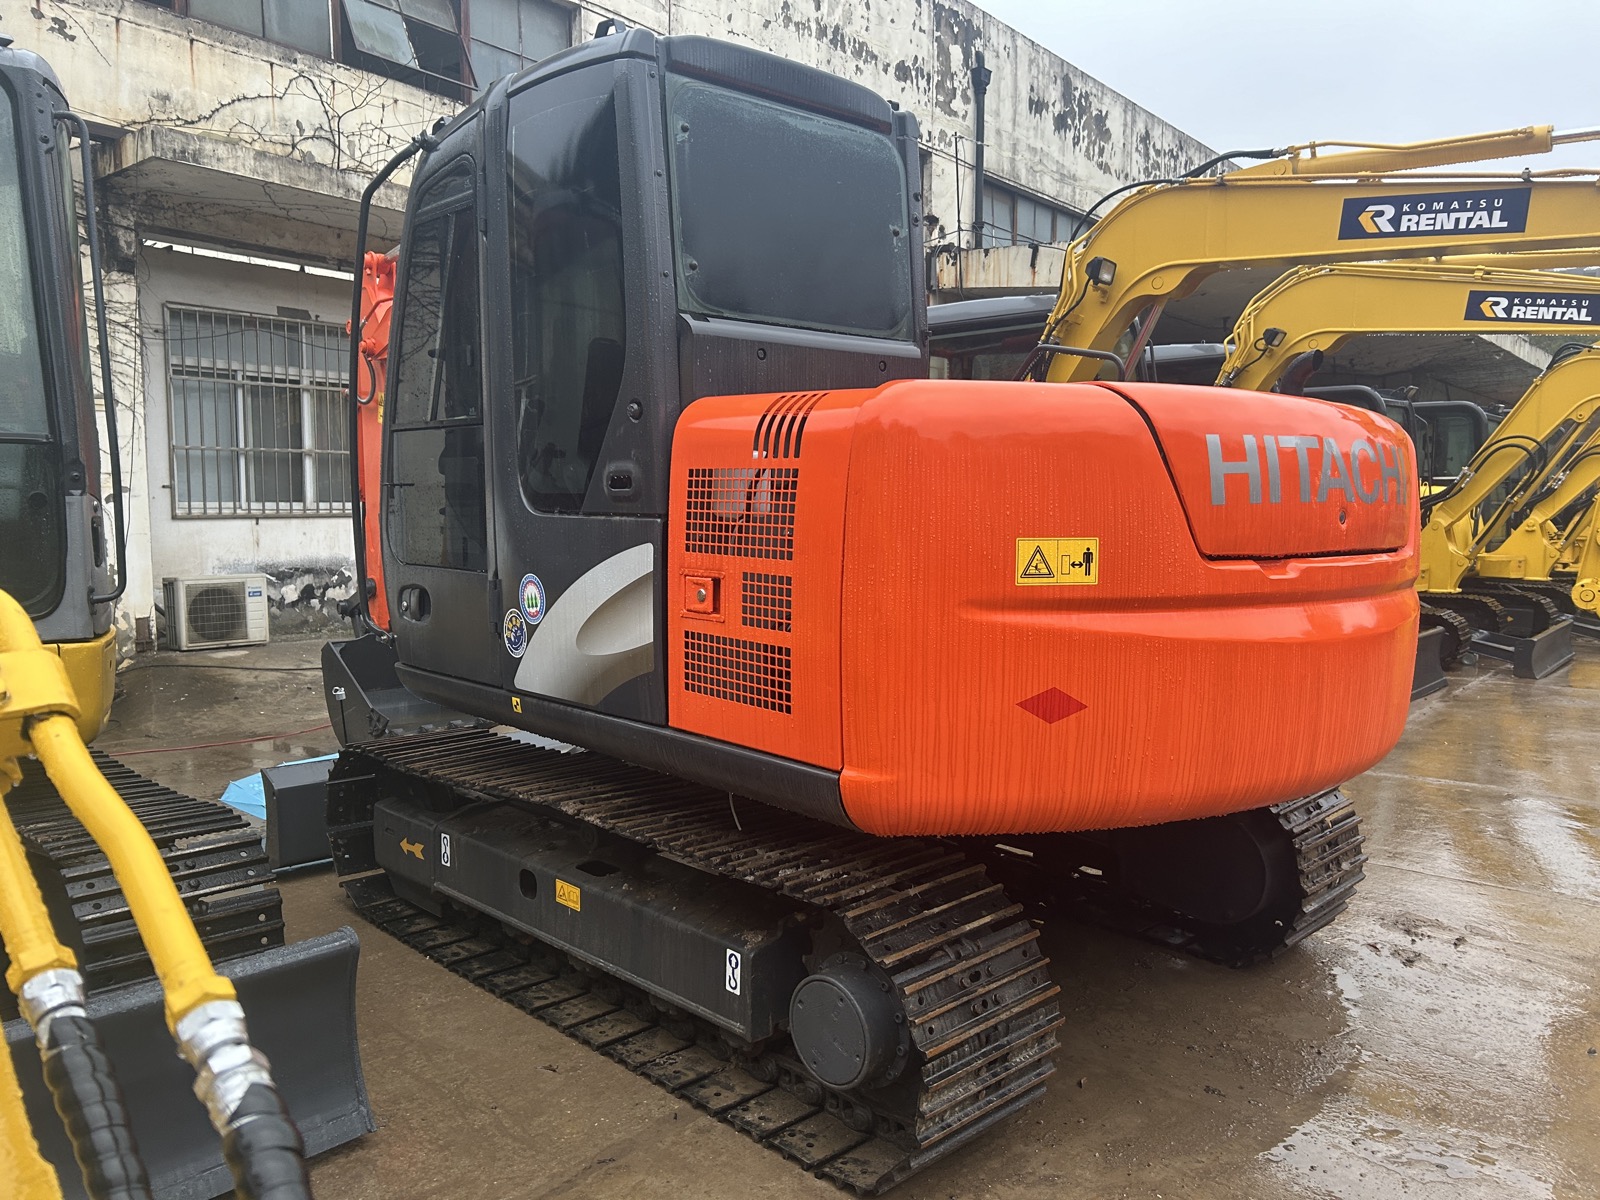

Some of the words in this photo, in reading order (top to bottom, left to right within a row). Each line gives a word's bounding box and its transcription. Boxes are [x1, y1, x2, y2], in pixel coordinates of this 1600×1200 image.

[1402, 198, 1504, 212] KOMATSU
[1399, 210, 1509, 232] RENTAL
[1513, 297, 1589, 306] KOMATSU
[1510, 305, 1593, 321] RENTAL
[1205, 433, 1408, 506] HITACHI
